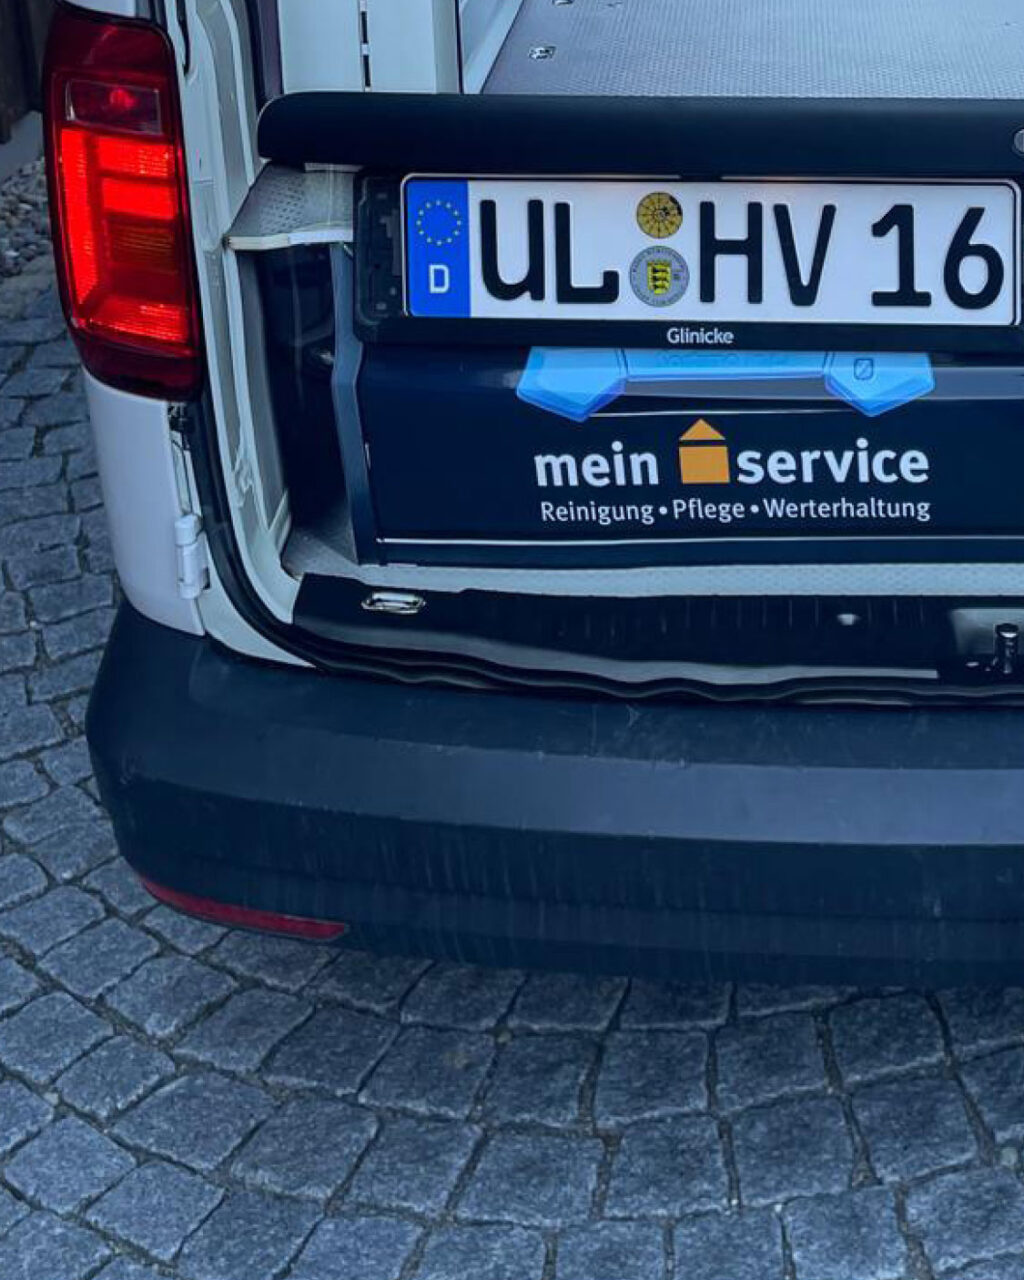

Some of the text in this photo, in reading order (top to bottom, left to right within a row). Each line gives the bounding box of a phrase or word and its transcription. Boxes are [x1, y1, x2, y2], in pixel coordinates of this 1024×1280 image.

[479, 199, 620, 305] UL
[699, 200, 837, 307] HV
[871, 203, 1004, 310] 16
[429, 264, 450, 294] D
[666, 327, 735, 344] Glinicke
[534, 437, 930, 487] mein service
[541, 497, 931, 525] Reinigung Pflege Werterhaltung
